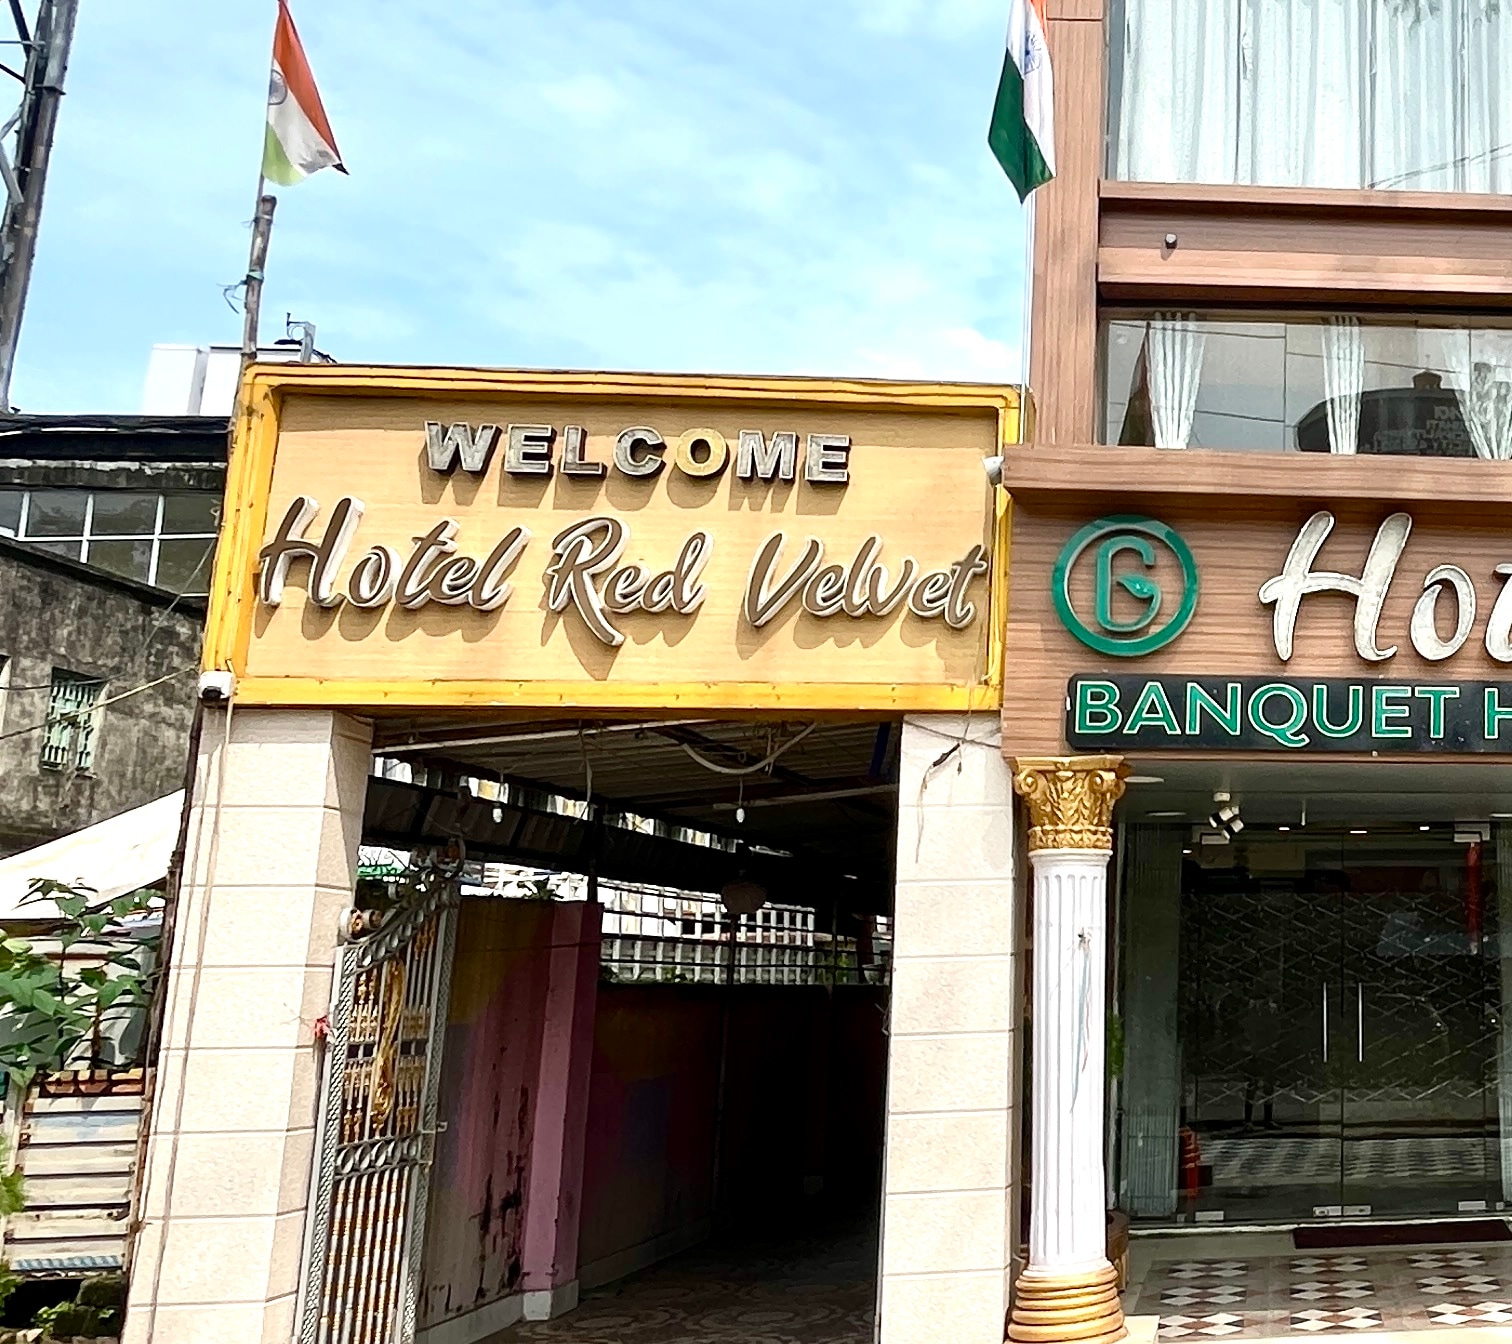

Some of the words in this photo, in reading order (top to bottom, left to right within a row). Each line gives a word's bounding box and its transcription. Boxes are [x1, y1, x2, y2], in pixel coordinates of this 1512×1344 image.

[424, 421, 851, 484] WELCOME
[259, 495, 532, 610] Hotel
[545, 516, 715, 646] Red
[744, 532, 989, 629] Velvet
[1074, 680, 1459, 747] BANQUET
